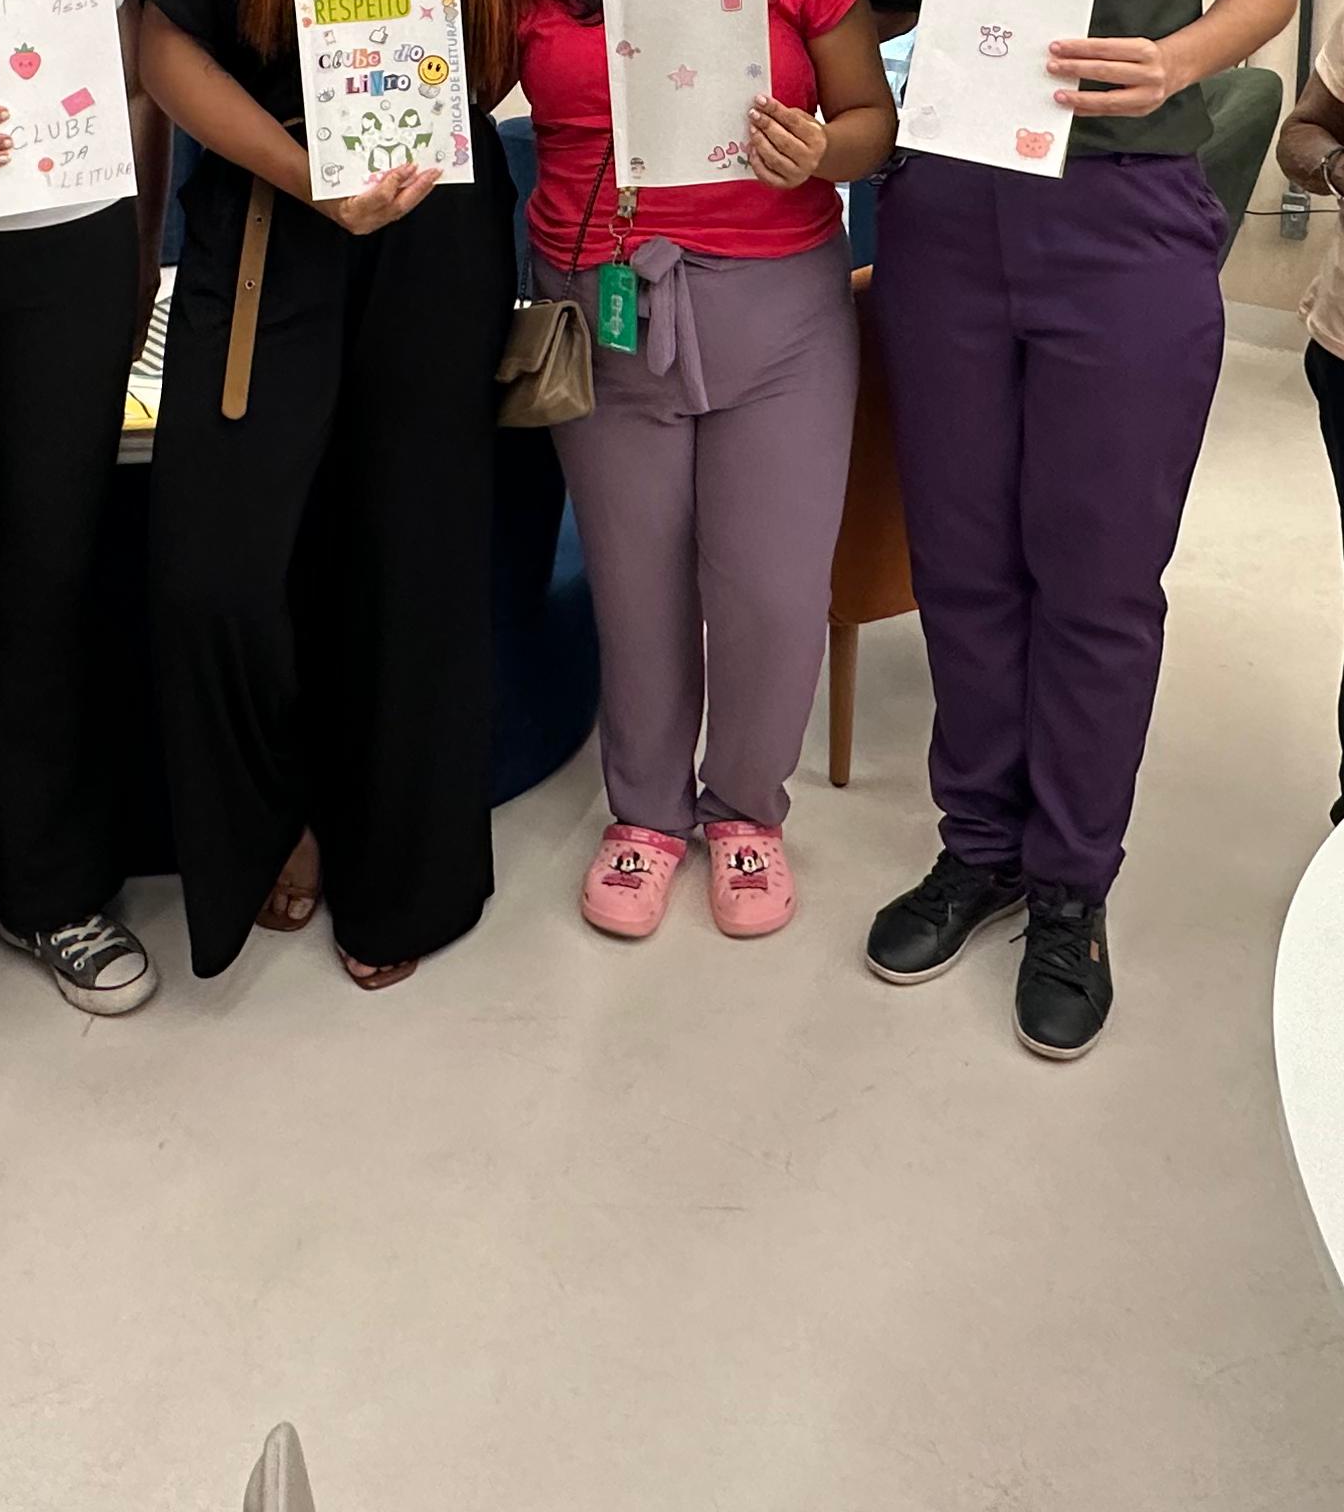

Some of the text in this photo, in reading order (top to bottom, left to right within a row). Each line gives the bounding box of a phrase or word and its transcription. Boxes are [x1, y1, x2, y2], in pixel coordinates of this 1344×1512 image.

[447, 21, 464, 133] DICAS DE LEITURA
[10, 116, 97, 151] CLUBE
[60, 146, 89, 166] DA
